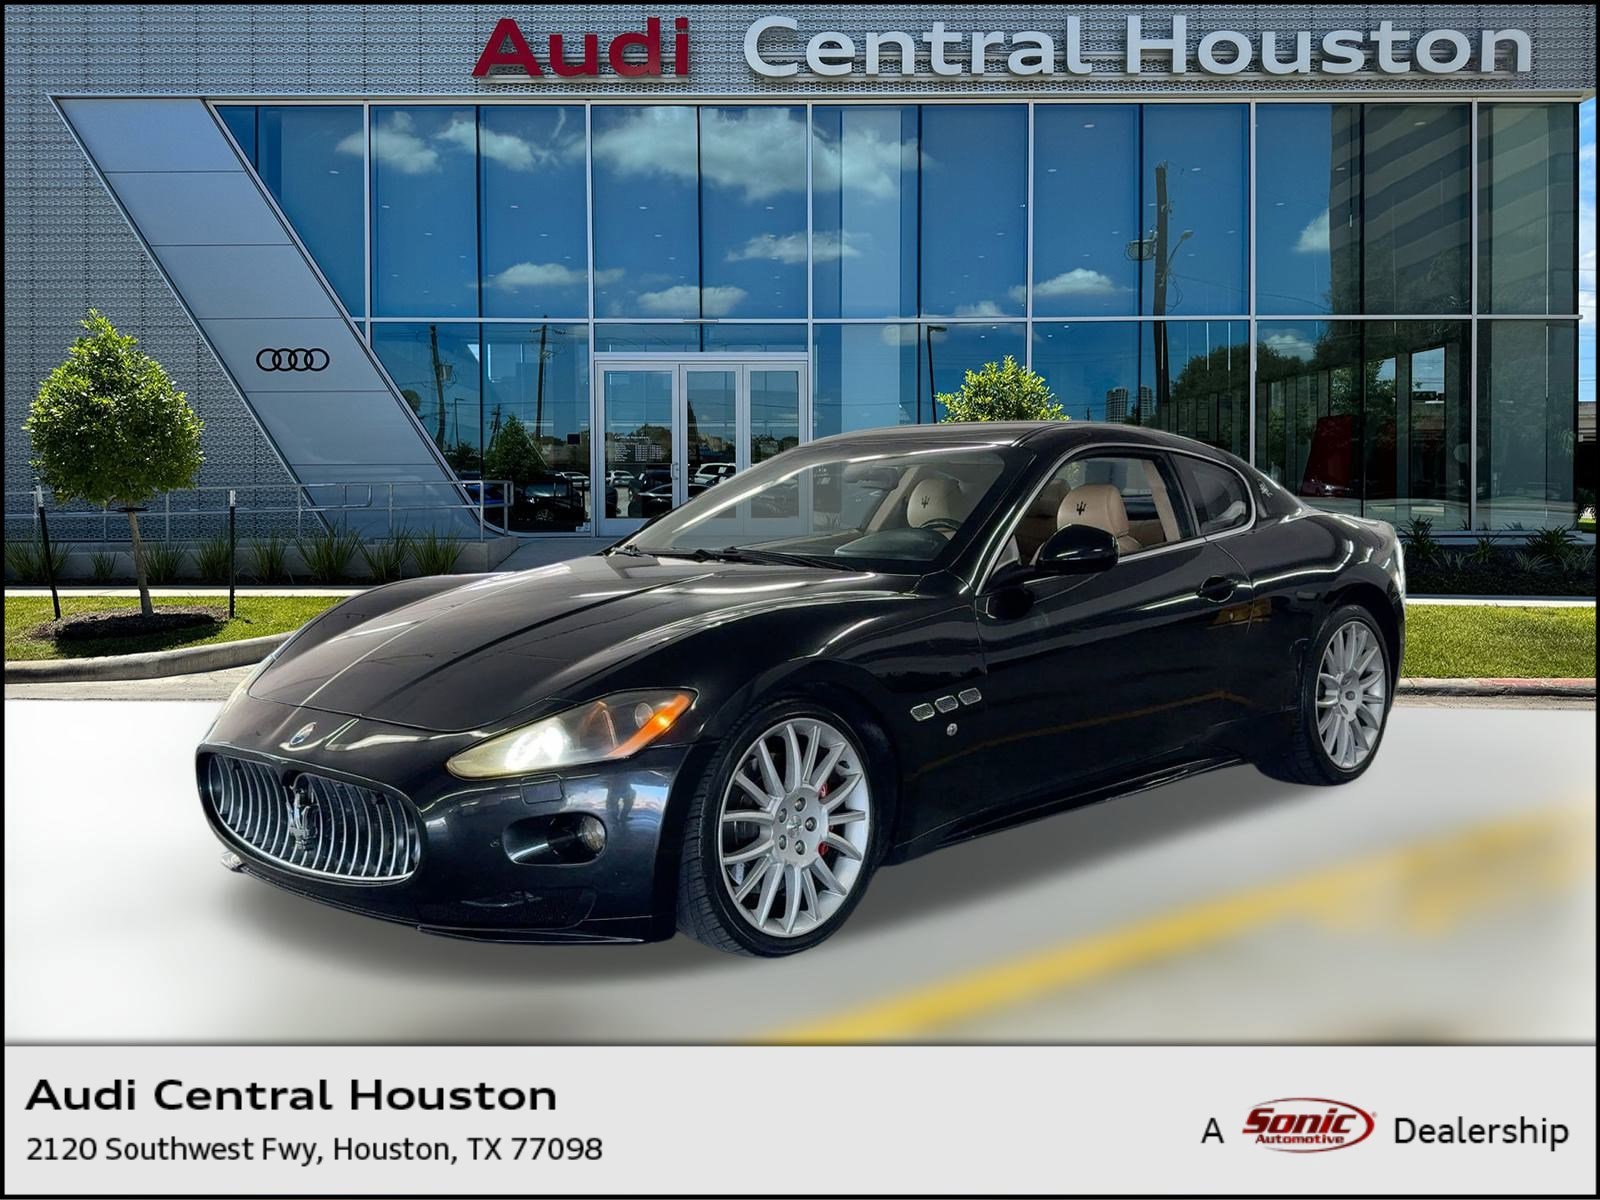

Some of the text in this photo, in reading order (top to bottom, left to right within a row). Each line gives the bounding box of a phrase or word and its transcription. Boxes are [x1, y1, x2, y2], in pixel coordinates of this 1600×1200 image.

[471, 15, 1532, 78] Audi Central Houston
